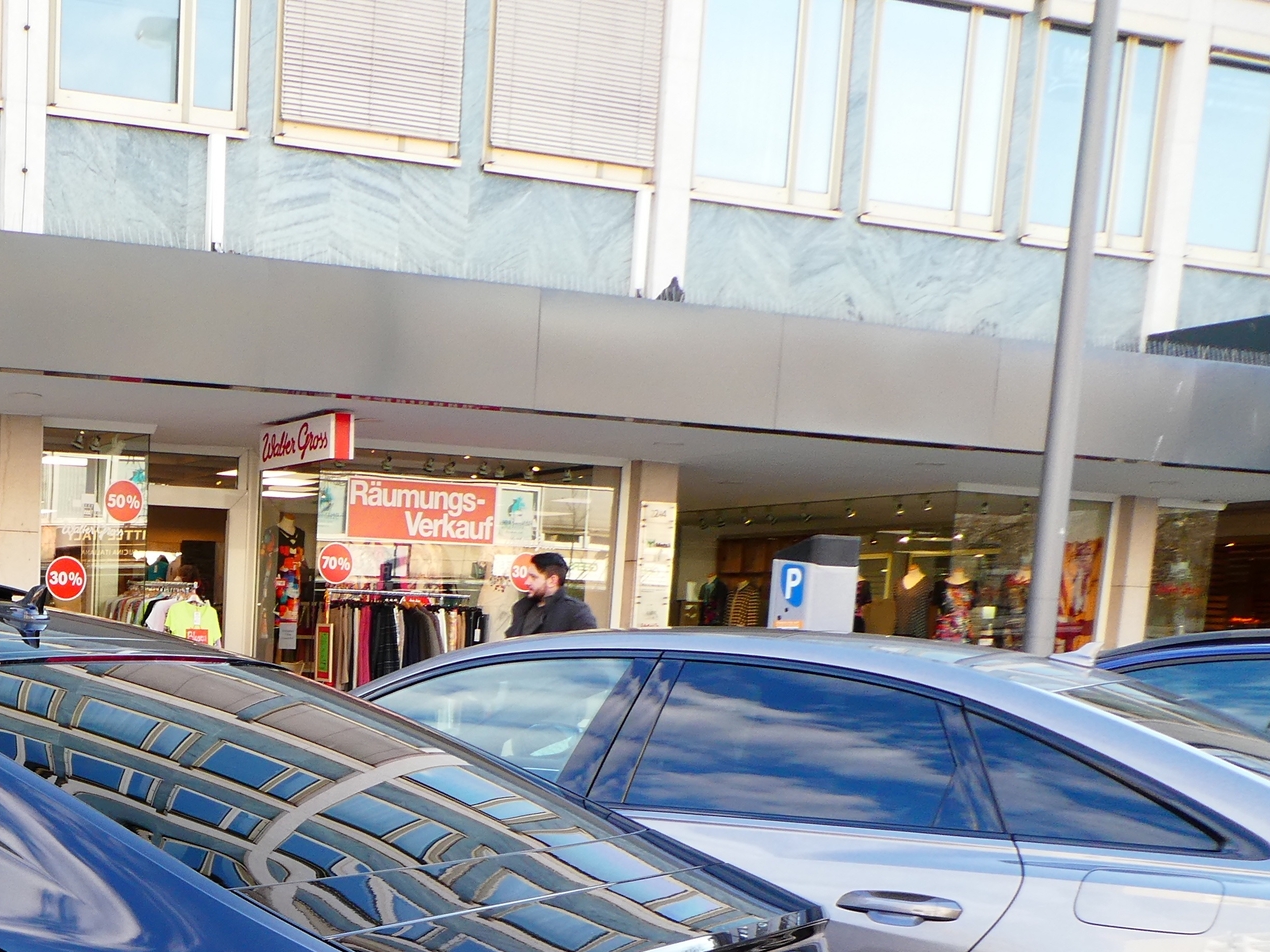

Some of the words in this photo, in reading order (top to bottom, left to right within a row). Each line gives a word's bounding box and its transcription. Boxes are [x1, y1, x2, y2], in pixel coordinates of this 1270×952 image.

[262, 431, 296, 463] Walter
[297, 422, 328, 460] Gross
[107, 493, 140, 509] 50%
[350, 479, 486, 516] Räumungs-
[404, 511, 494, 540] Verkauf
[321, 555, 351, 572] 70%
[511, 564, 528, 579] 30
[49, 570, 83, 587] 30%
[785, 567, 803, 600] P
